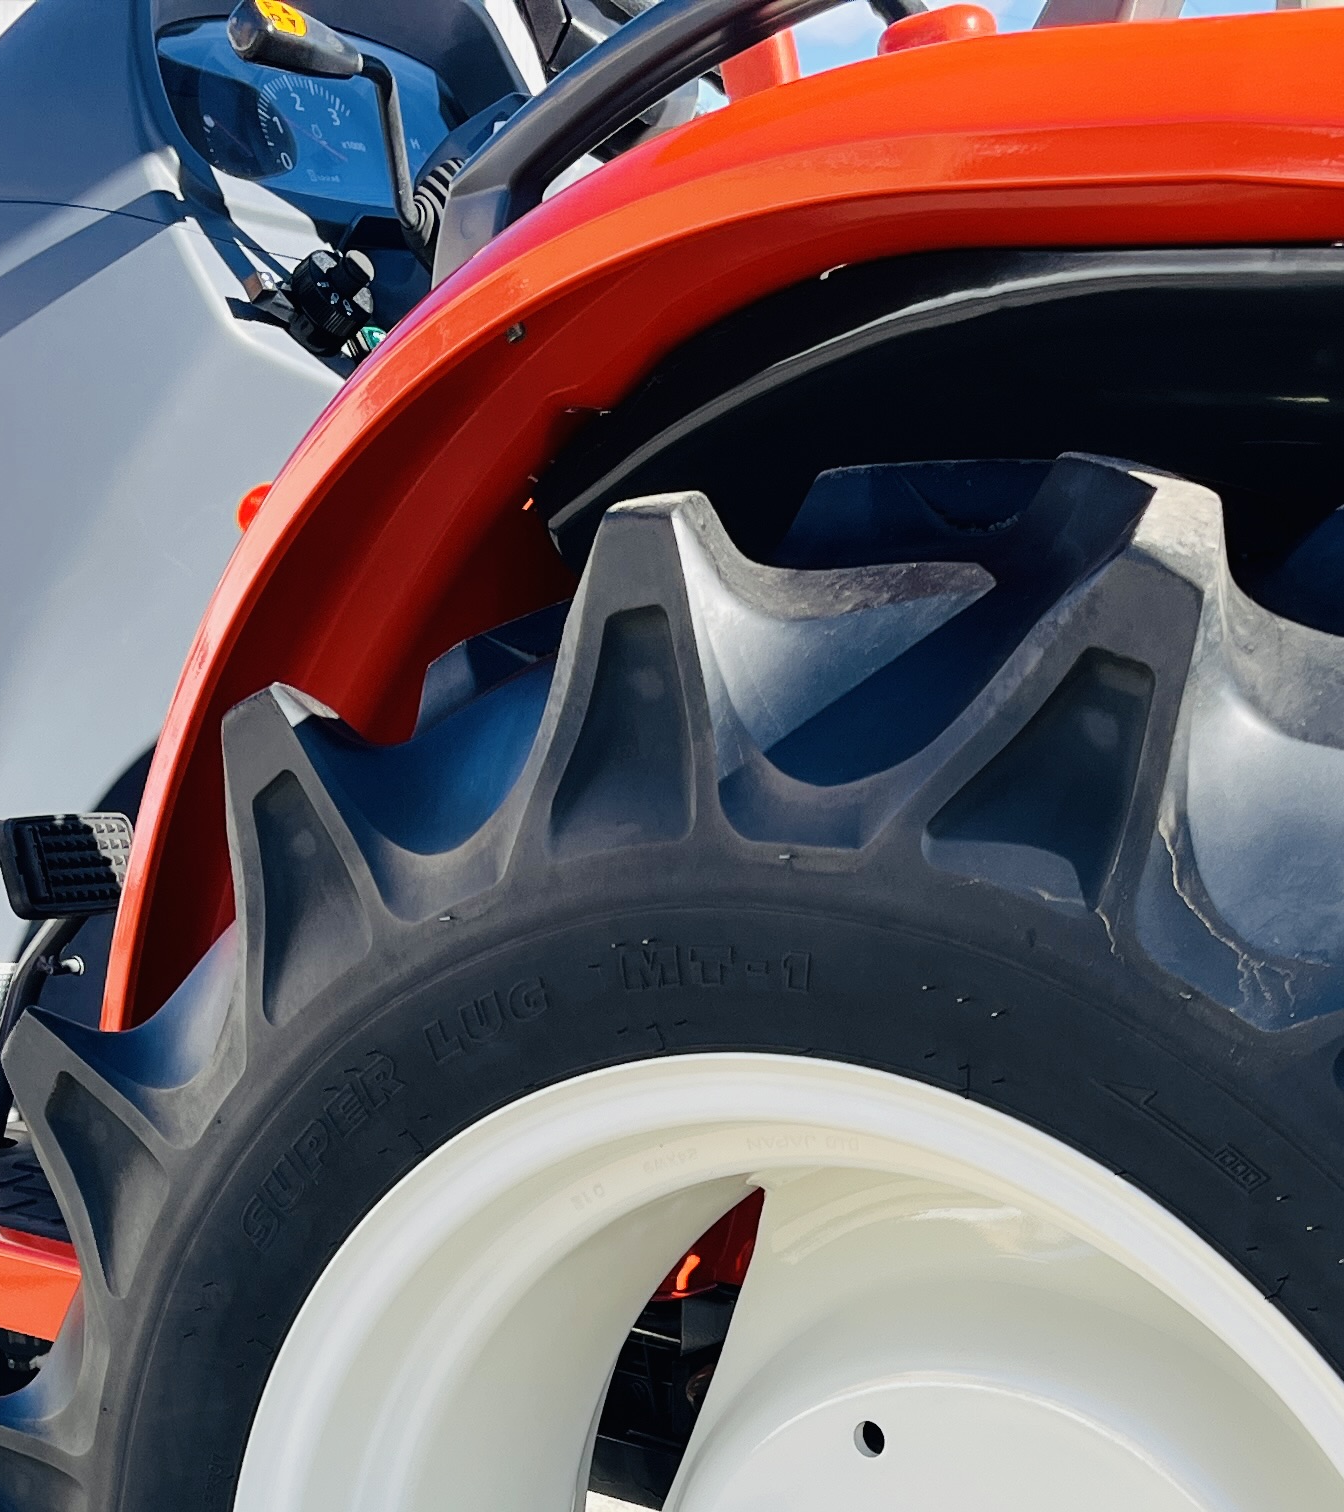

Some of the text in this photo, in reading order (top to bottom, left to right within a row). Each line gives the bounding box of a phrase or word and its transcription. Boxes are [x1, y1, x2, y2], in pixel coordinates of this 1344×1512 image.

[240, 943, 812, 1248] SUPER LUG MT-1
